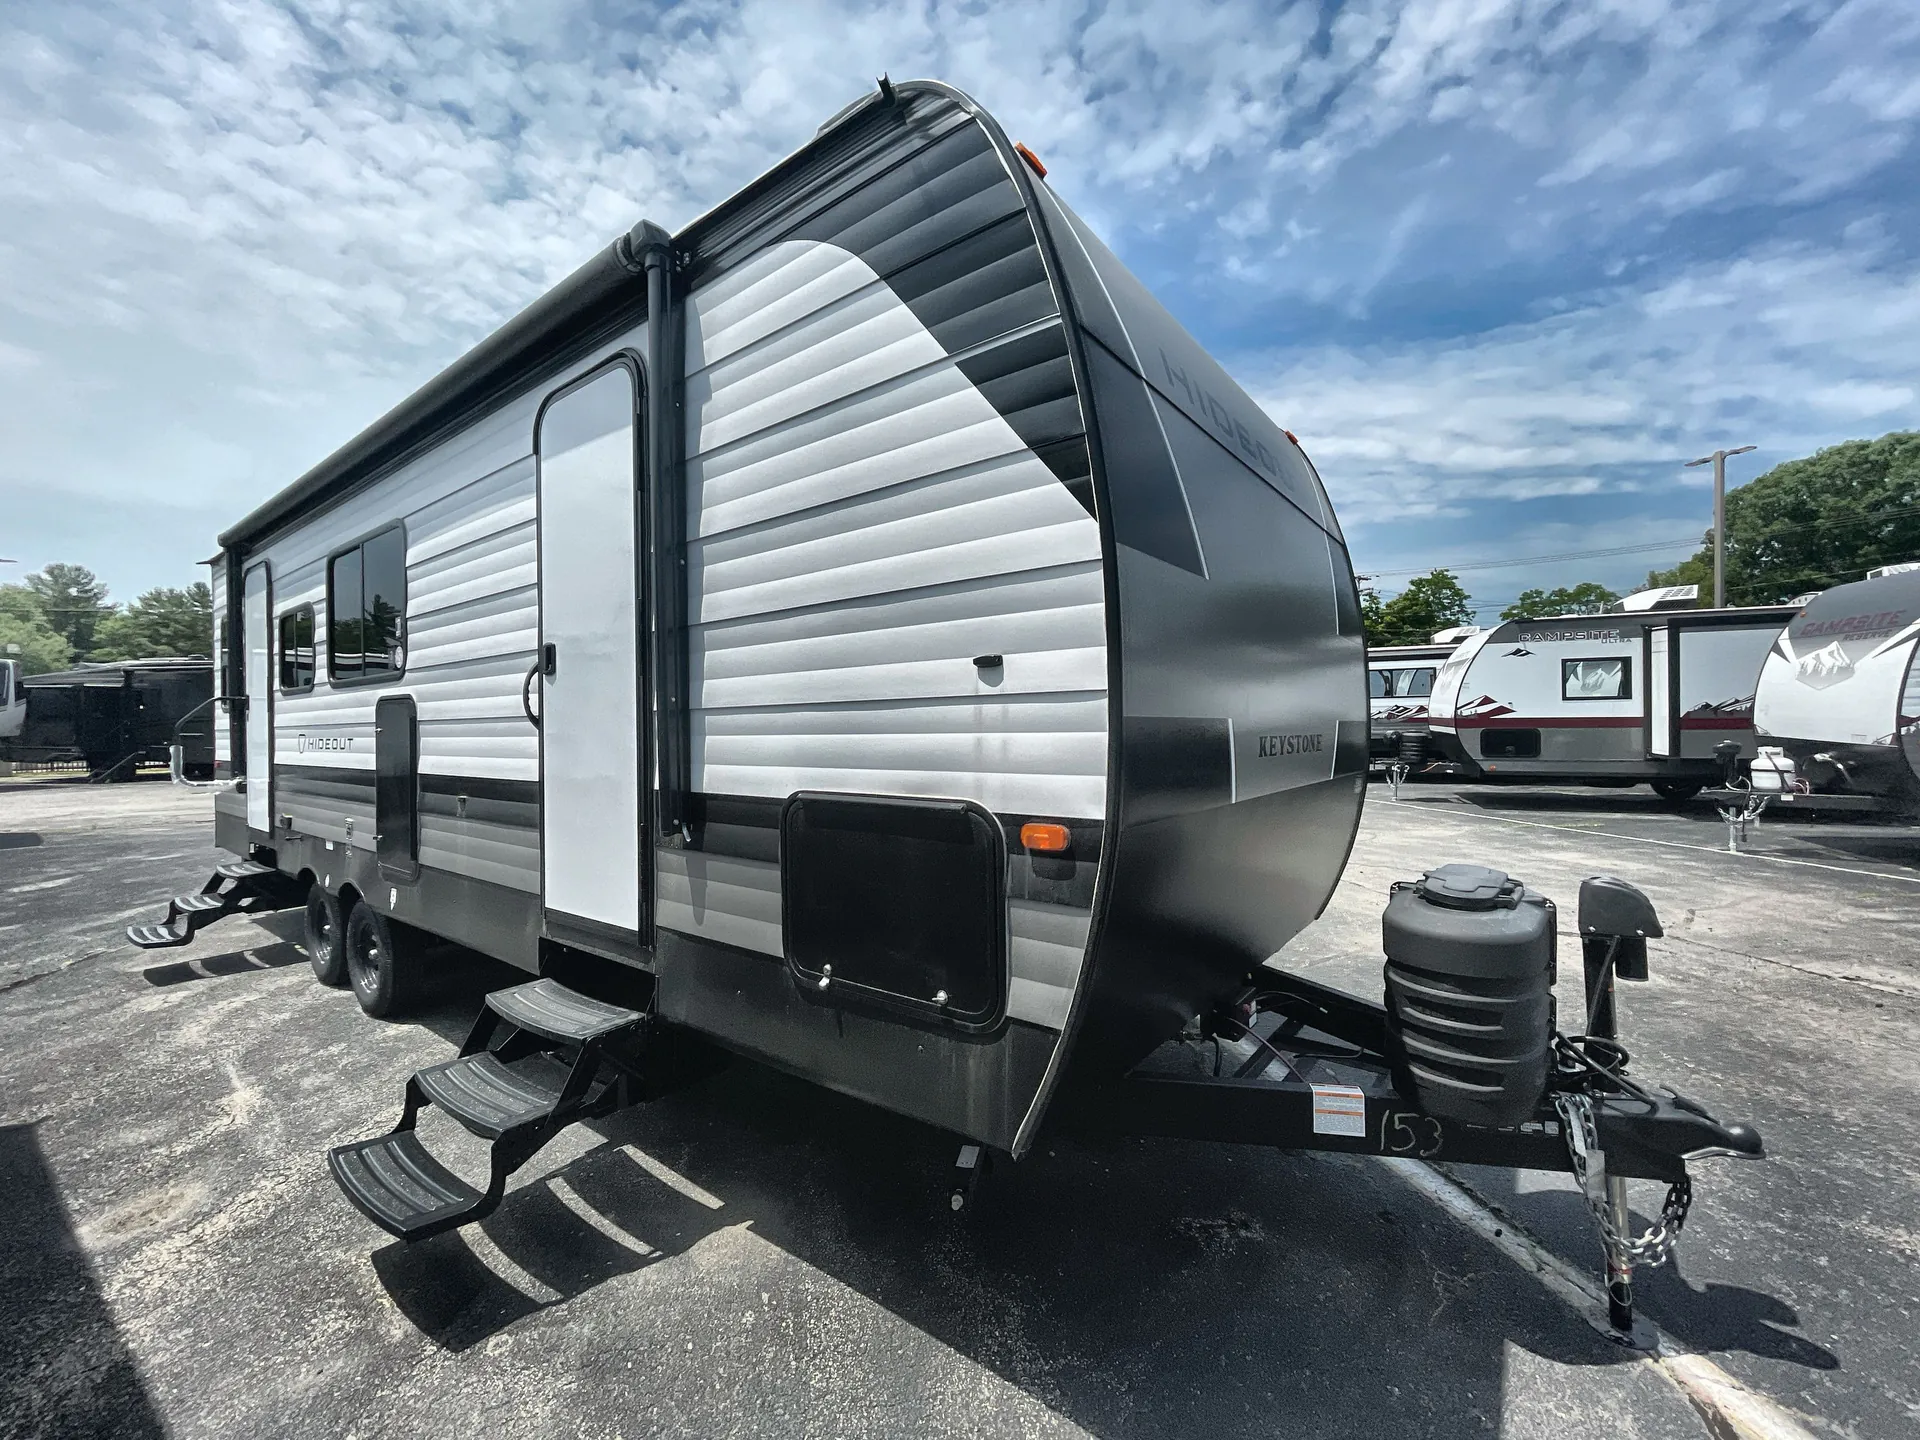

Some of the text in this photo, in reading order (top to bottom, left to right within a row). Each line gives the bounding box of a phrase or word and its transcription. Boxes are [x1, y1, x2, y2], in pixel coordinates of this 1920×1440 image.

[1801, 609, 1906, 636] CAMPSITE
[1519, 629, 1620, 642] CAMPSITE
[307, 738, 353, 750] HIDEOUT
[1258, 734, 1322, 758] KEYSTONE
[1379, 1109, 1444, 1157] 153
